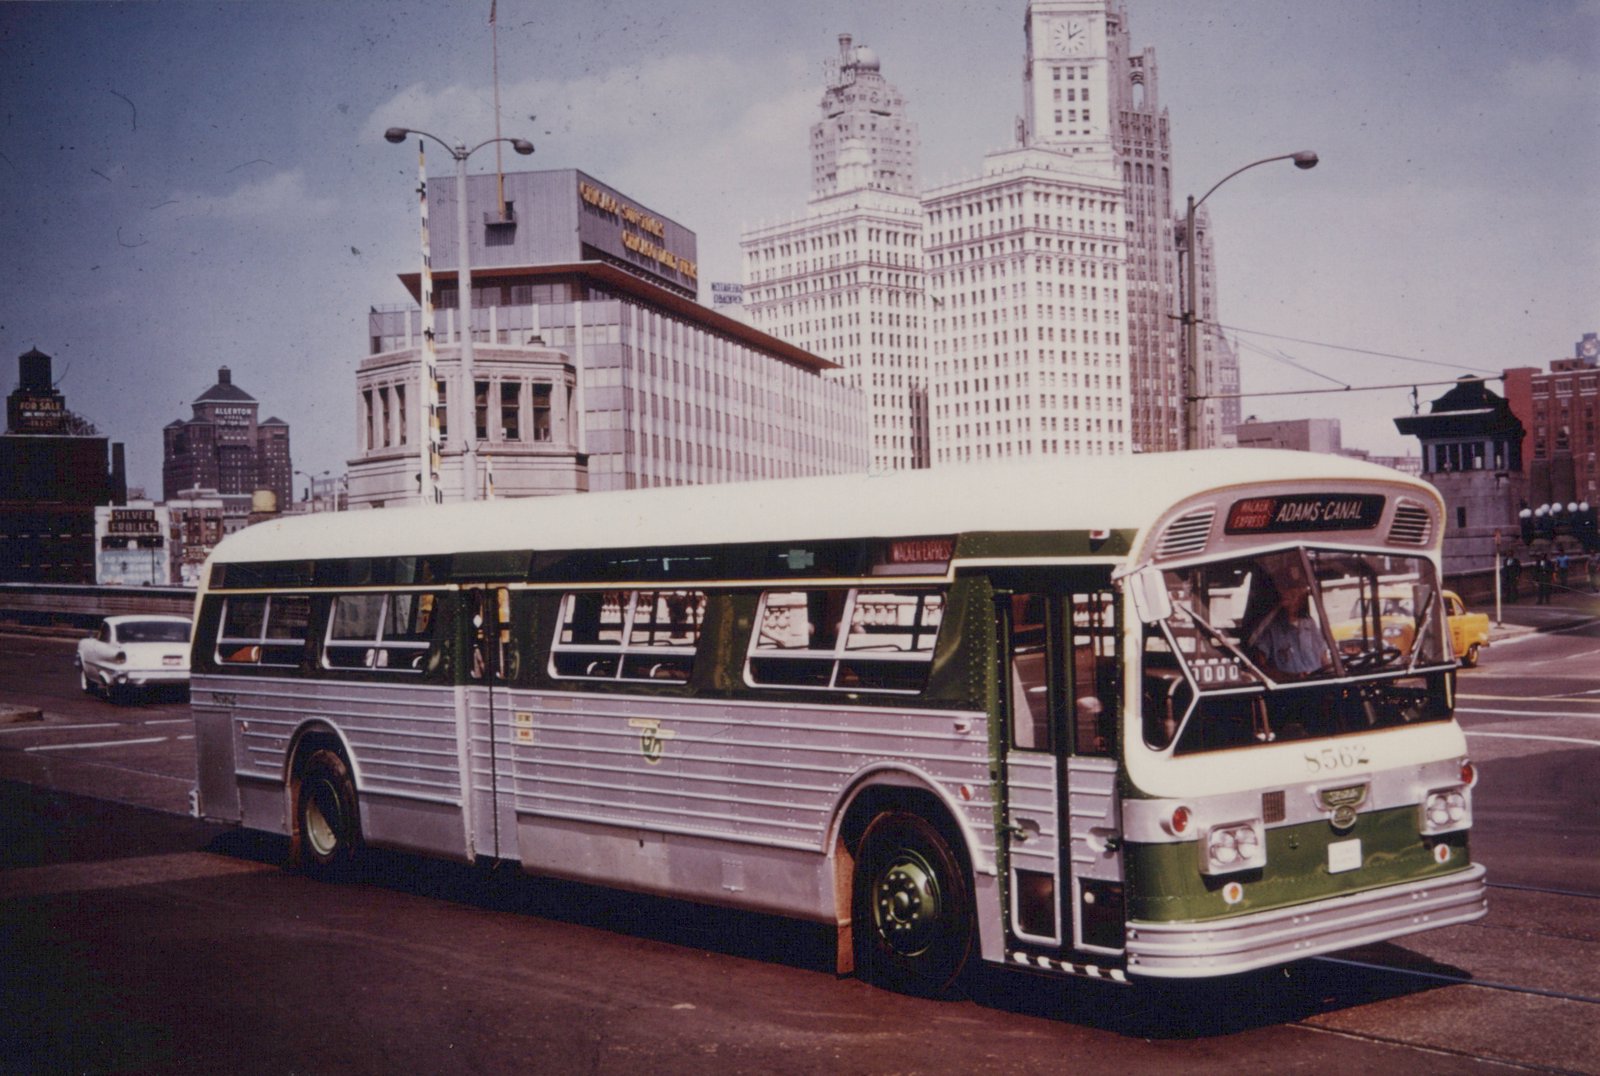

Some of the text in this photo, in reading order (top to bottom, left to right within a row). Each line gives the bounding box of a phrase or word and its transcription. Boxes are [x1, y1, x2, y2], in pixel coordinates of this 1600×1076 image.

[19, 401, 37, 410] FOR
[215, 407, 252, 415] ALLERTON
[114, 511, 153, 520] SILVER
[1233, 514, 1267, 528] EXPRESS
[111, 522, 157, 532] FROLICS
[1303, 745, 1370, 774] 8562
